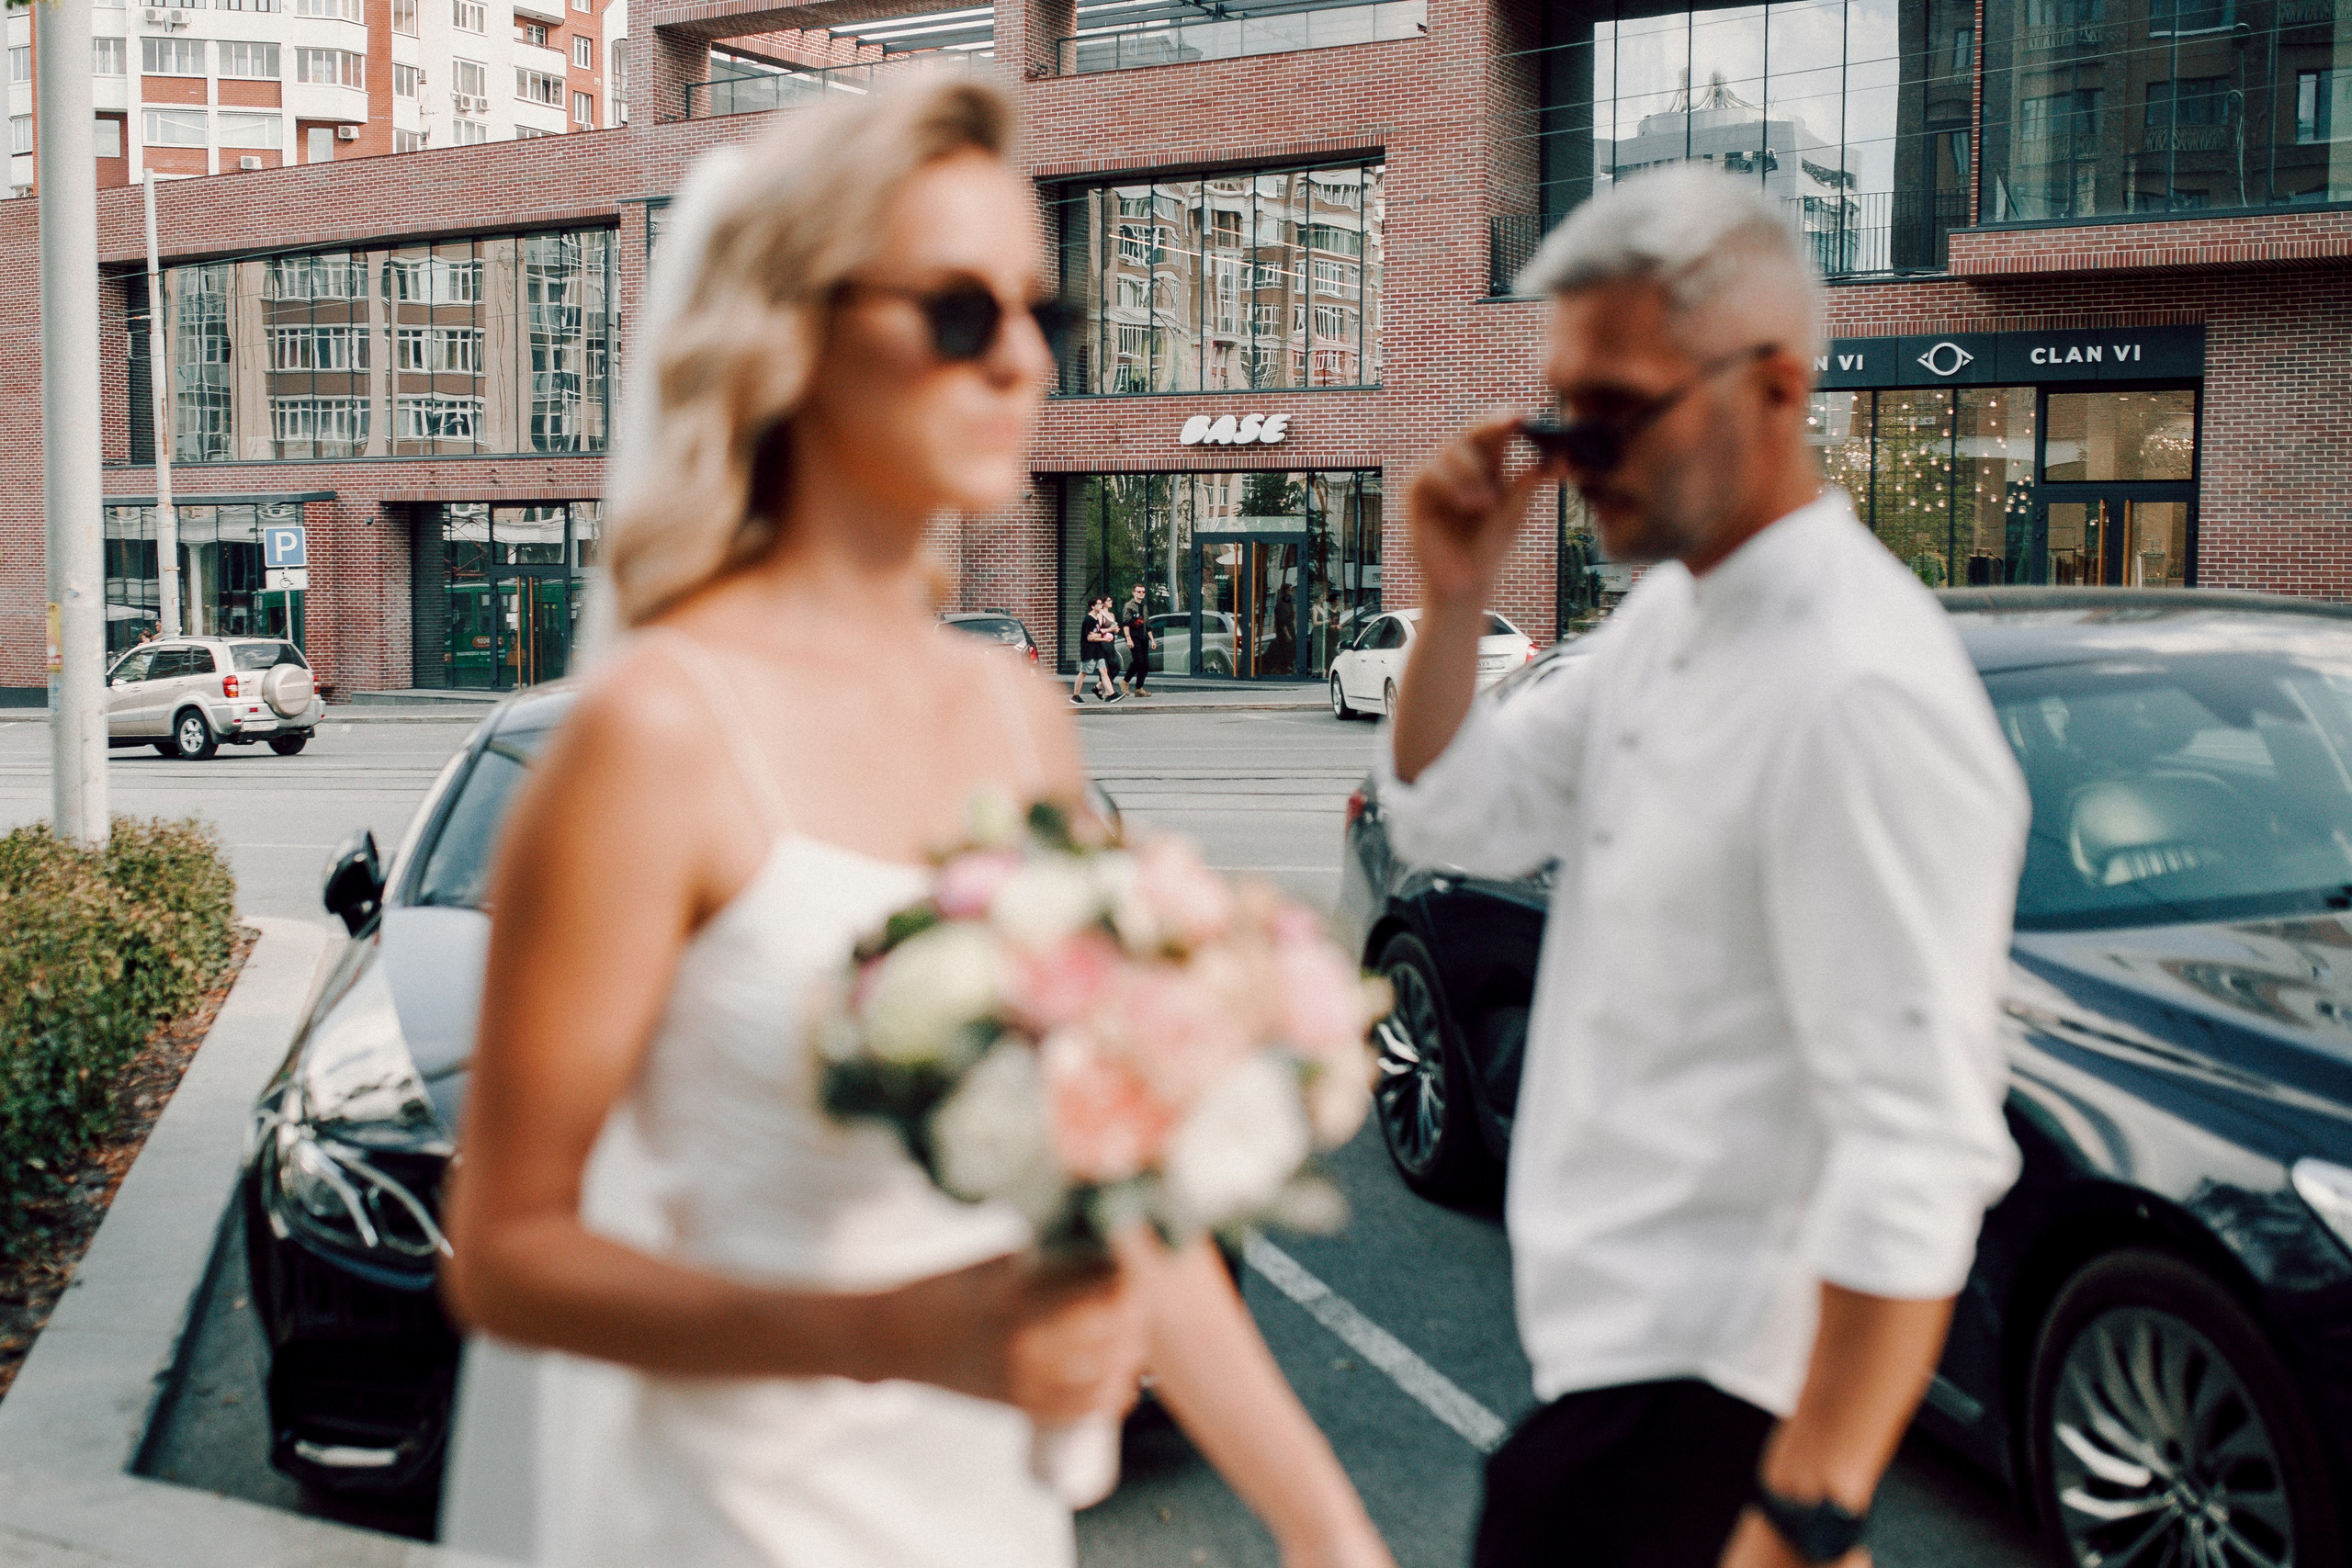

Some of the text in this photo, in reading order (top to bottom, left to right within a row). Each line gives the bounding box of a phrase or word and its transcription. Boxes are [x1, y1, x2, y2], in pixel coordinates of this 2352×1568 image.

[1838, 355, 1863, 370] VI
[2030, 344, 2141, 365] CLAN VI
[1180, 413, 1292, 445] BASE
[275, 531, 298, 562] P
